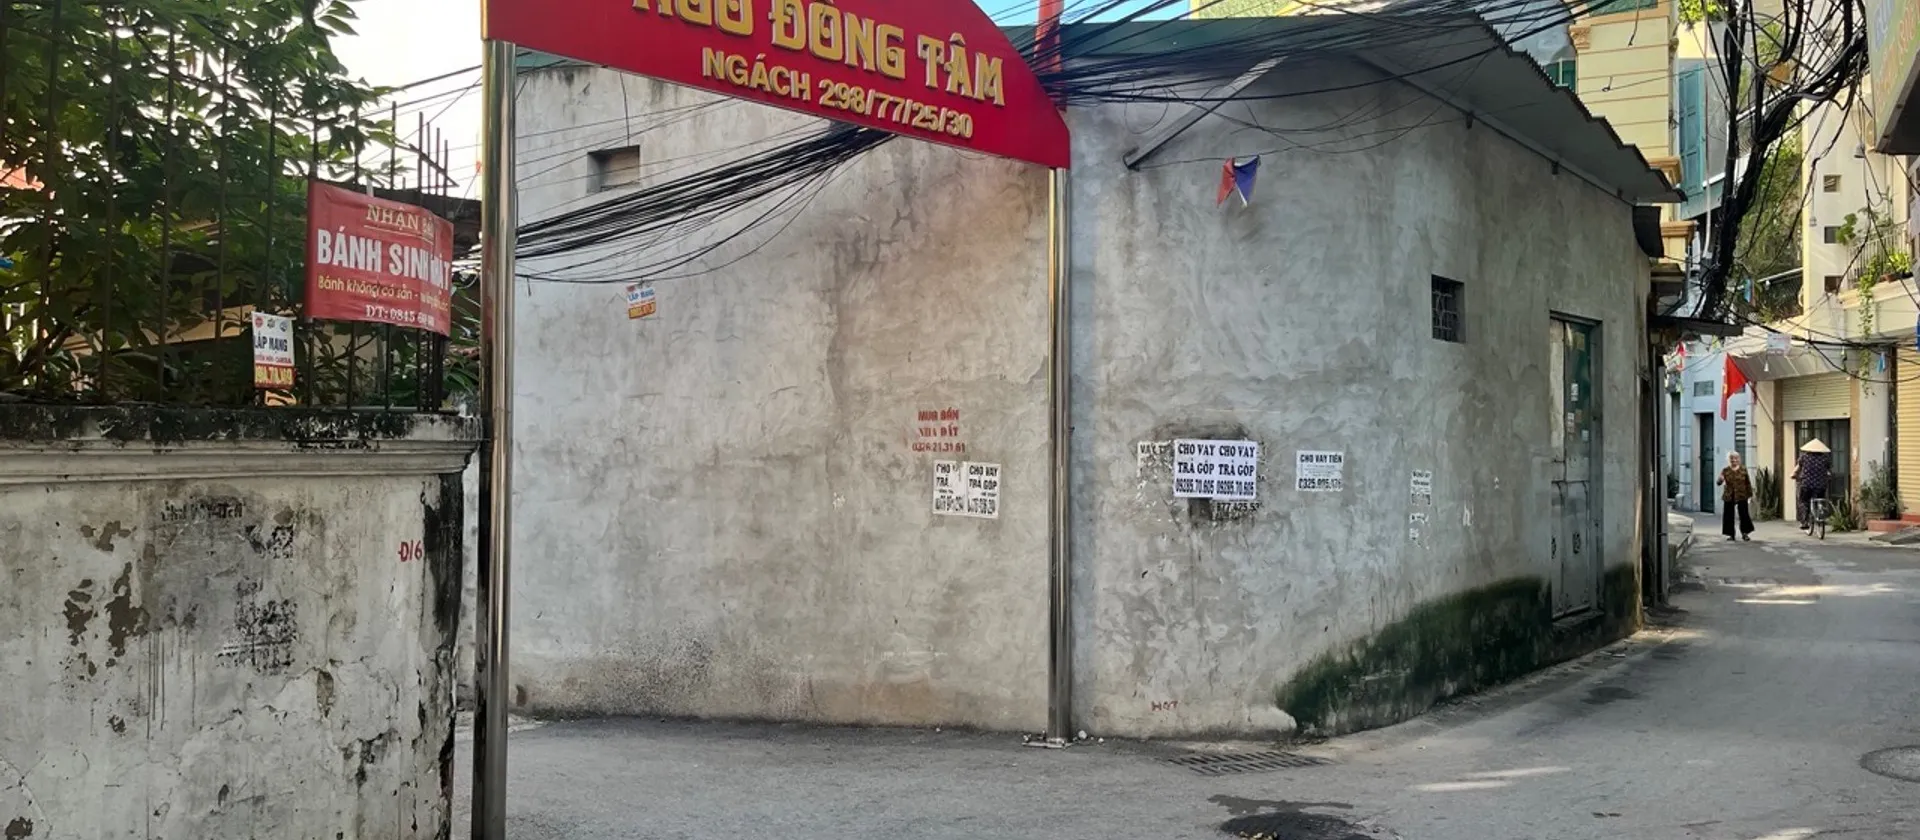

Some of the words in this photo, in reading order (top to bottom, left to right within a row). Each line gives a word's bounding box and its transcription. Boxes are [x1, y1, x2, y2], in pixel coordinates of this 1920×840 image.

[917, 32, 1005, 106] TÂM
[702, 47, 811, 100] NGÁCH
[818, 79, 973, 139] 298/77/25/30
[366, 204, 418, 231] NHẬN
[317, 226, 382, 273] BÁNH
[389, 244, 428, 281] SINH
[318, 275, 344, 292] Bánh
[346, 279, 379, 299] không
[381, 281, 395, 297] có
[918, 410, 938, 421] MUA
[940, 407, 959, 421] BÁN
[1178, 443, 1195, 455] CHO
[1198, 444, 1215, 456] VAY
[1219, 445, 1235, 457] CHO
[1237, 446, 1255, 458] VAY
[1178, 458, 1195, 474] TRẢ
[1197, 460, 1215, 474] GÓP
[1300, 454, 1313, 463] CHO
[1316, 455, 1327, 463] VAY
[969, 465, 983, 475] CHO
[986, 467, 998, 477] VAY
[1218, 459, 1235, 476] TRẢ
[1237, 461, 1255, 477] GÓP
